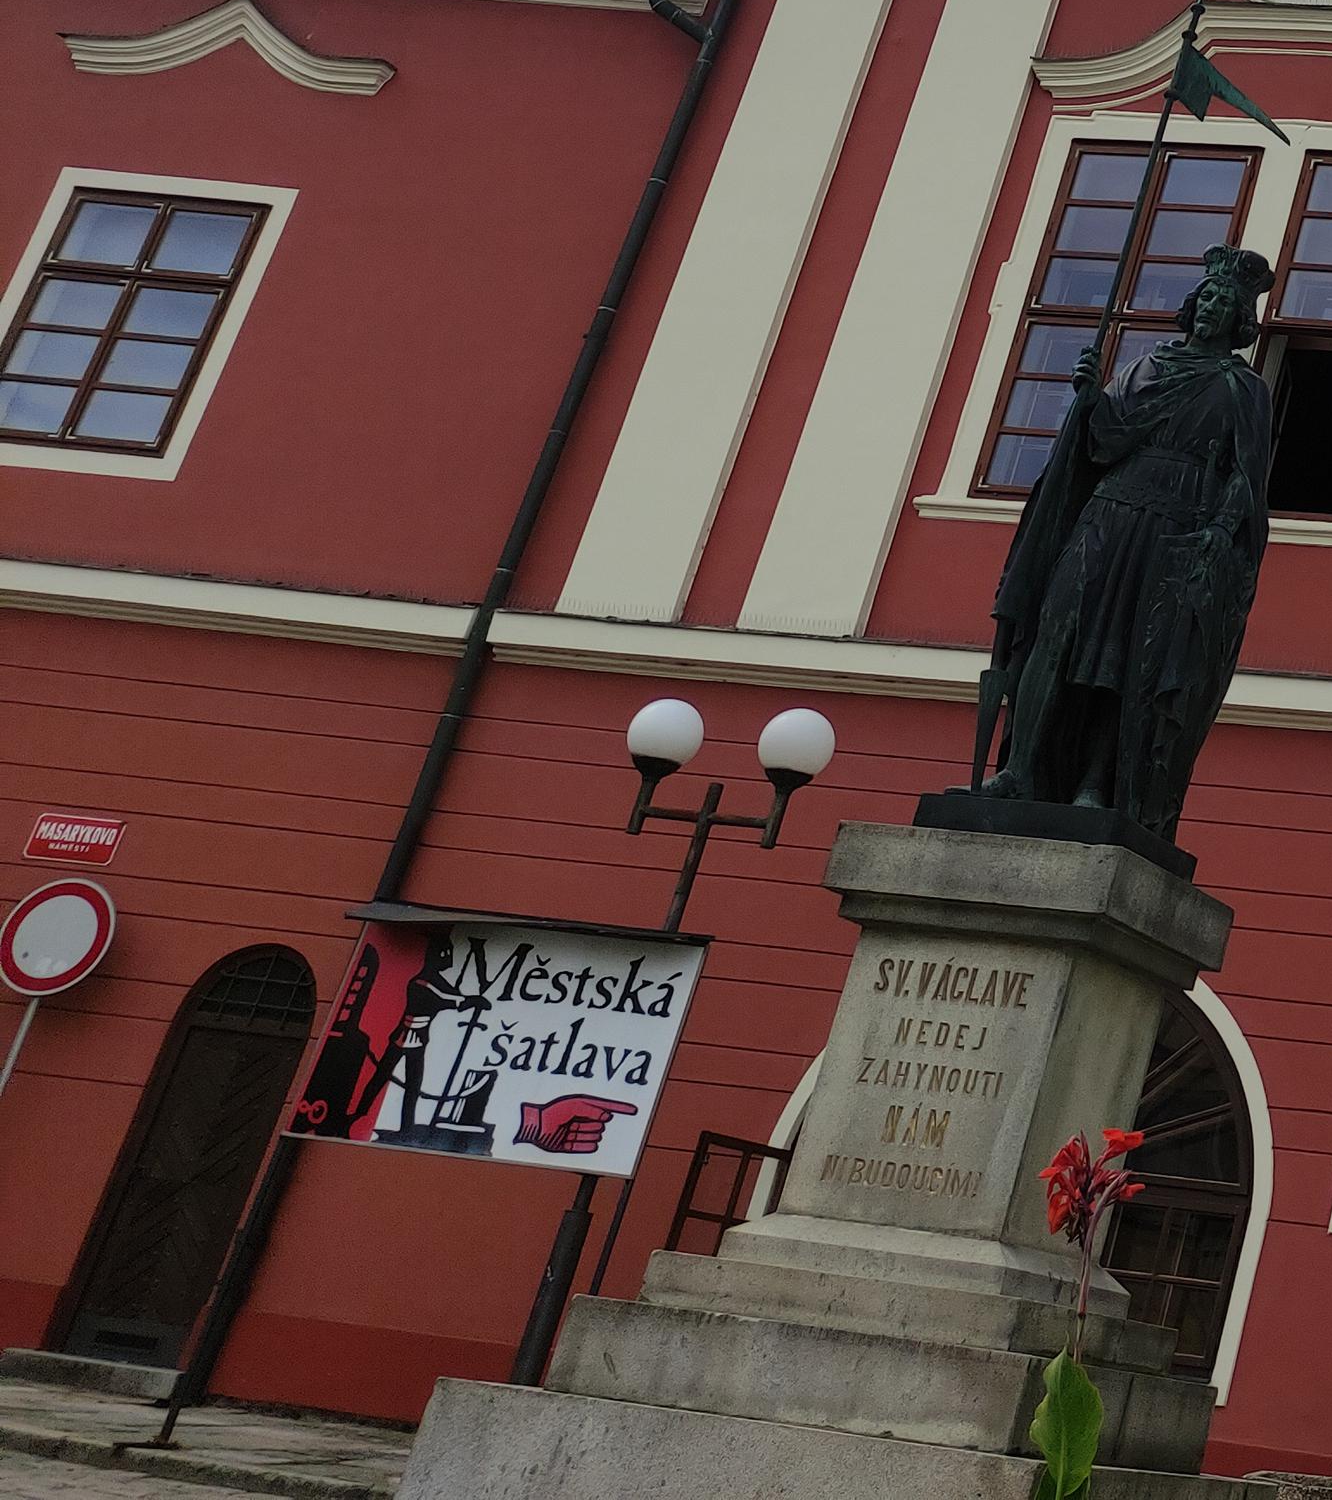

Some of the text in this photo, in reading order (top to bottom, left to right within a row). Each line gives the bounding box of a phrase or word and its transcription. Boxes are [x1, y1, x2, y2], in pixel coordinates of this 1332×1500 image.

[35, 821, 118, 846] MASARYKOVO
[453, 936, 683, 1018] Městská
[482, 1017, 652, 1086] šatlava
[894, 1017, 989, 1051] NEDEJ
[856, 1056, 1005, 1099] ZAHYNOUTI
[880, 1101, 952, 1149] NÁM
